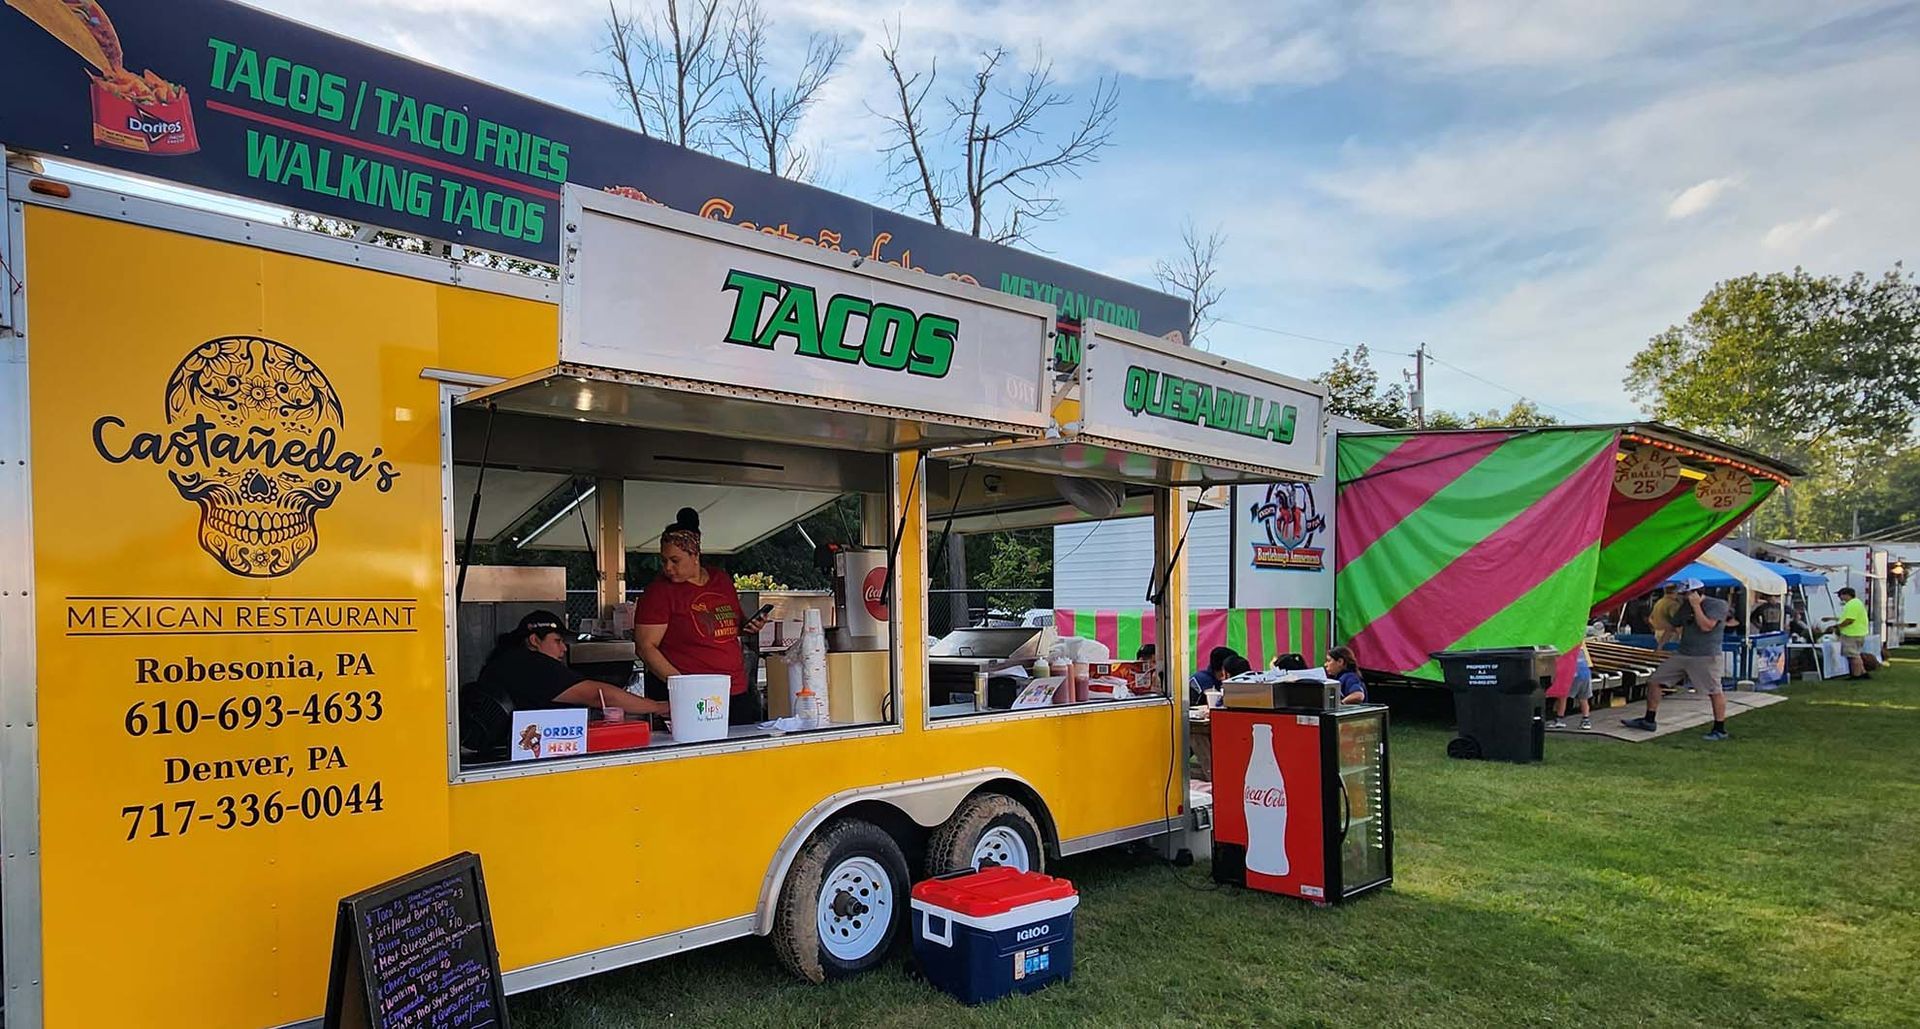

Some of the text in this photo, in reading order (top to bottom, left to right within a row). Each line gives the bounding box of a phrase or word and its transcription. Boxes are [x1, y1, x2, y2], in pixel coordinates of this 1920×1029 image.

[129, 116, 181, 134] Doritos
[208, 38, 570, 184] TACOS / TACO FRIES
[247, 129, 546, 244] WALKING TACOS
[1000, 272, 1090, 320] MEXICAN
[720, 268, 960, 379] TACOS
[1124, 365, 1298, 445] QUESADILLAS
[92, 413, 401, 493] Castañeda's
[1630, 470, 1662, 479] BALLS
[68, 606, 416, 628] MEXICAN RESTAURANT
[135, 652, 375, 684] Robesonia, PA
[124, 690, 383, 736] 610-693-4633
[543, 726, 583, 737] ORDER
[548, 742, 578, 752] HERE
[163, 745, 348, 785] Denver, PA
[121, 781, 384, 841] 717-336-0044
[1245, 786, 1285, 807] oca-Cola
[400, 926, 448, 956] Quesadilla
[1016, 924, 1050, 942] IGLOO
